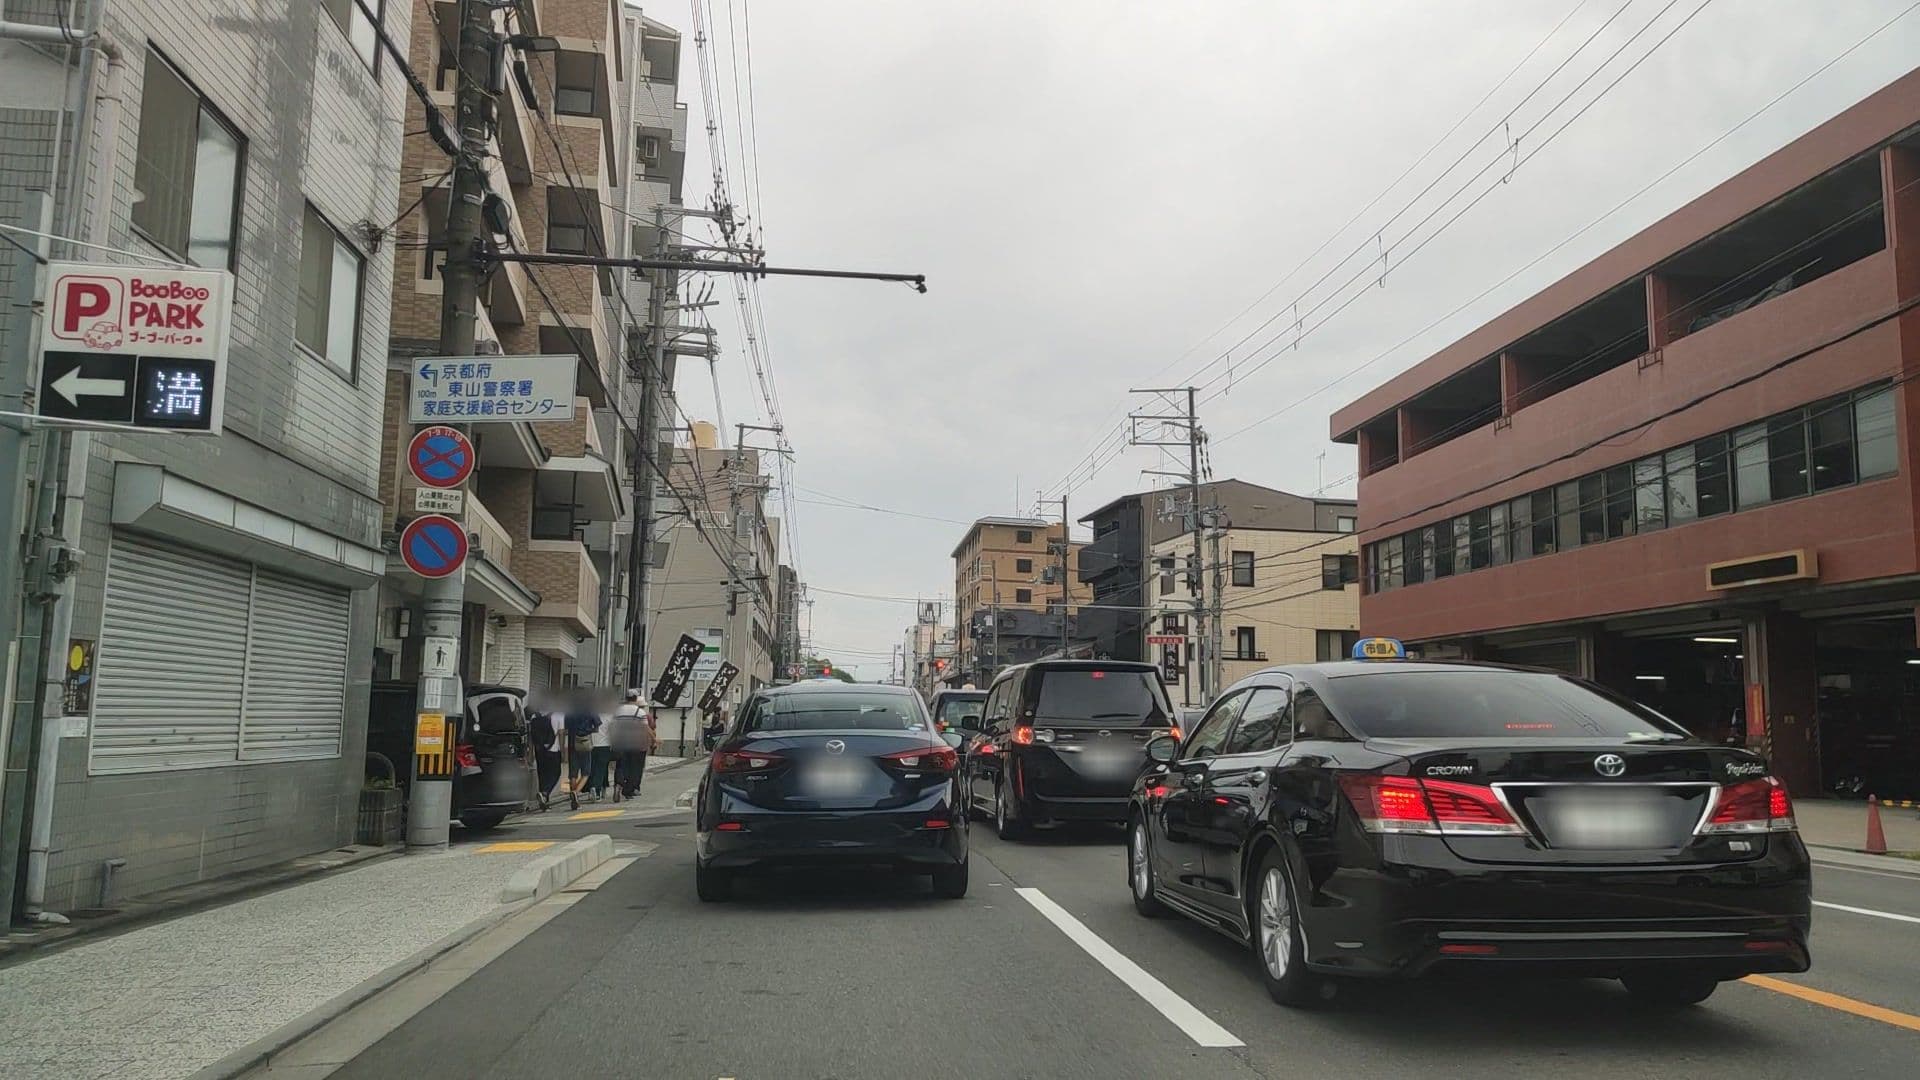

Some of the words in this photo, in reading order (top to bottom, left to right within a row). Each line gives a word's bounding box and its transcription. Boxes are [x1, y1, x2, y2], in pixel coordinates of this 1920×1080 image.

[131, 279, 209, 300] BooBoo
[64, 283, 110, 332] P
[129, 302, 204, 329] PARK
[441, 363, 492, 379] 京都府
[153, 371, 203, 415] 満
[418, 390, 437, 399] 100m
[448, 380, 533, 397] 東山警察署
[423, 399, 568, 416] 家庭支援総合センター
[1365, 643, 1398, 655] 市個人
[1426, 765, 1473, 776] CROWN
